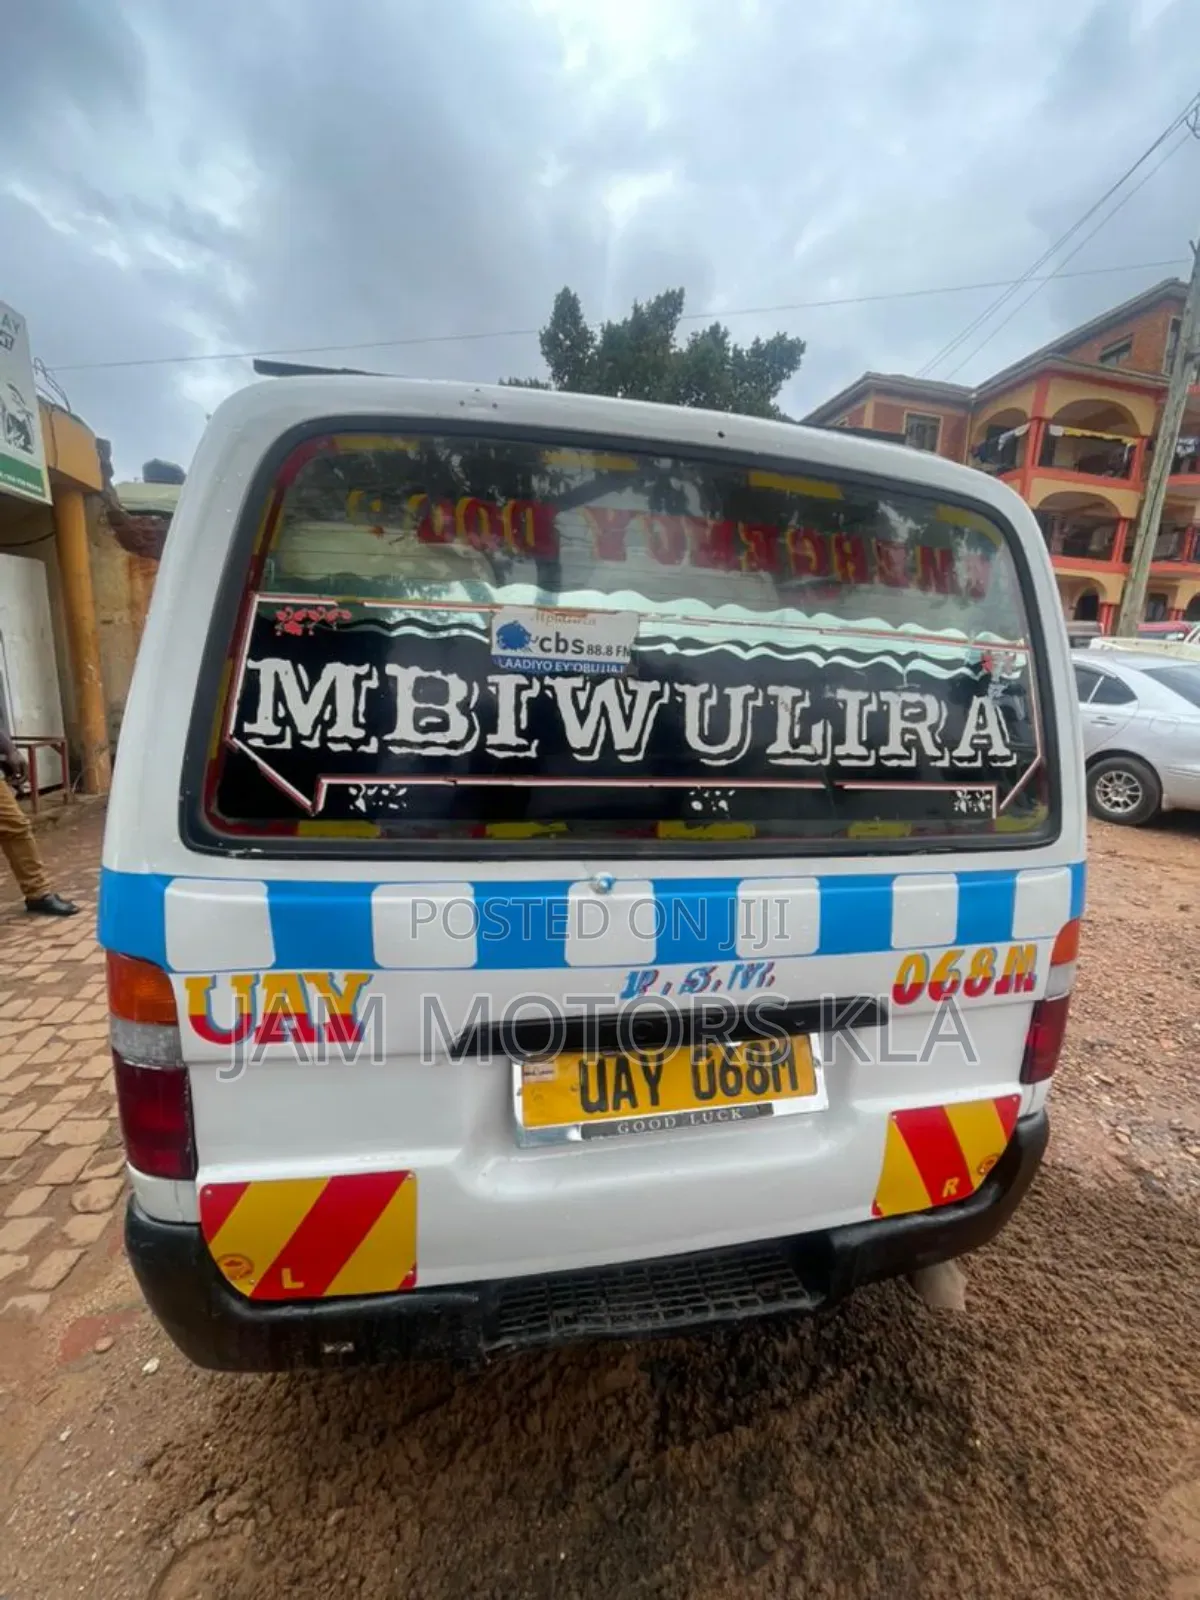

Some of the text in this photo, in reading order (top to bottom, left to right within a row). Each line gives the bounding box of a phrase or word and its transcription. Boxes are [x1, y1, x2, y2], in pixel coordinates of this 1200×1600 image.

[538, 632, 584, 655] cbs
[586, 644, 614, 657] 88.8
[243, 658, 1017, 767] MBIWULIRA
[892, 943, 1038, 1005] 068M
[185, 972, 373, 1046] UAY
[578, 1037, 799, 1114] UAY 068M
[617, 1105, 745, 1134] GOOD LUCK
[942, 1177, 960, 1198] R
[281, 1267, 304, 1289] L
